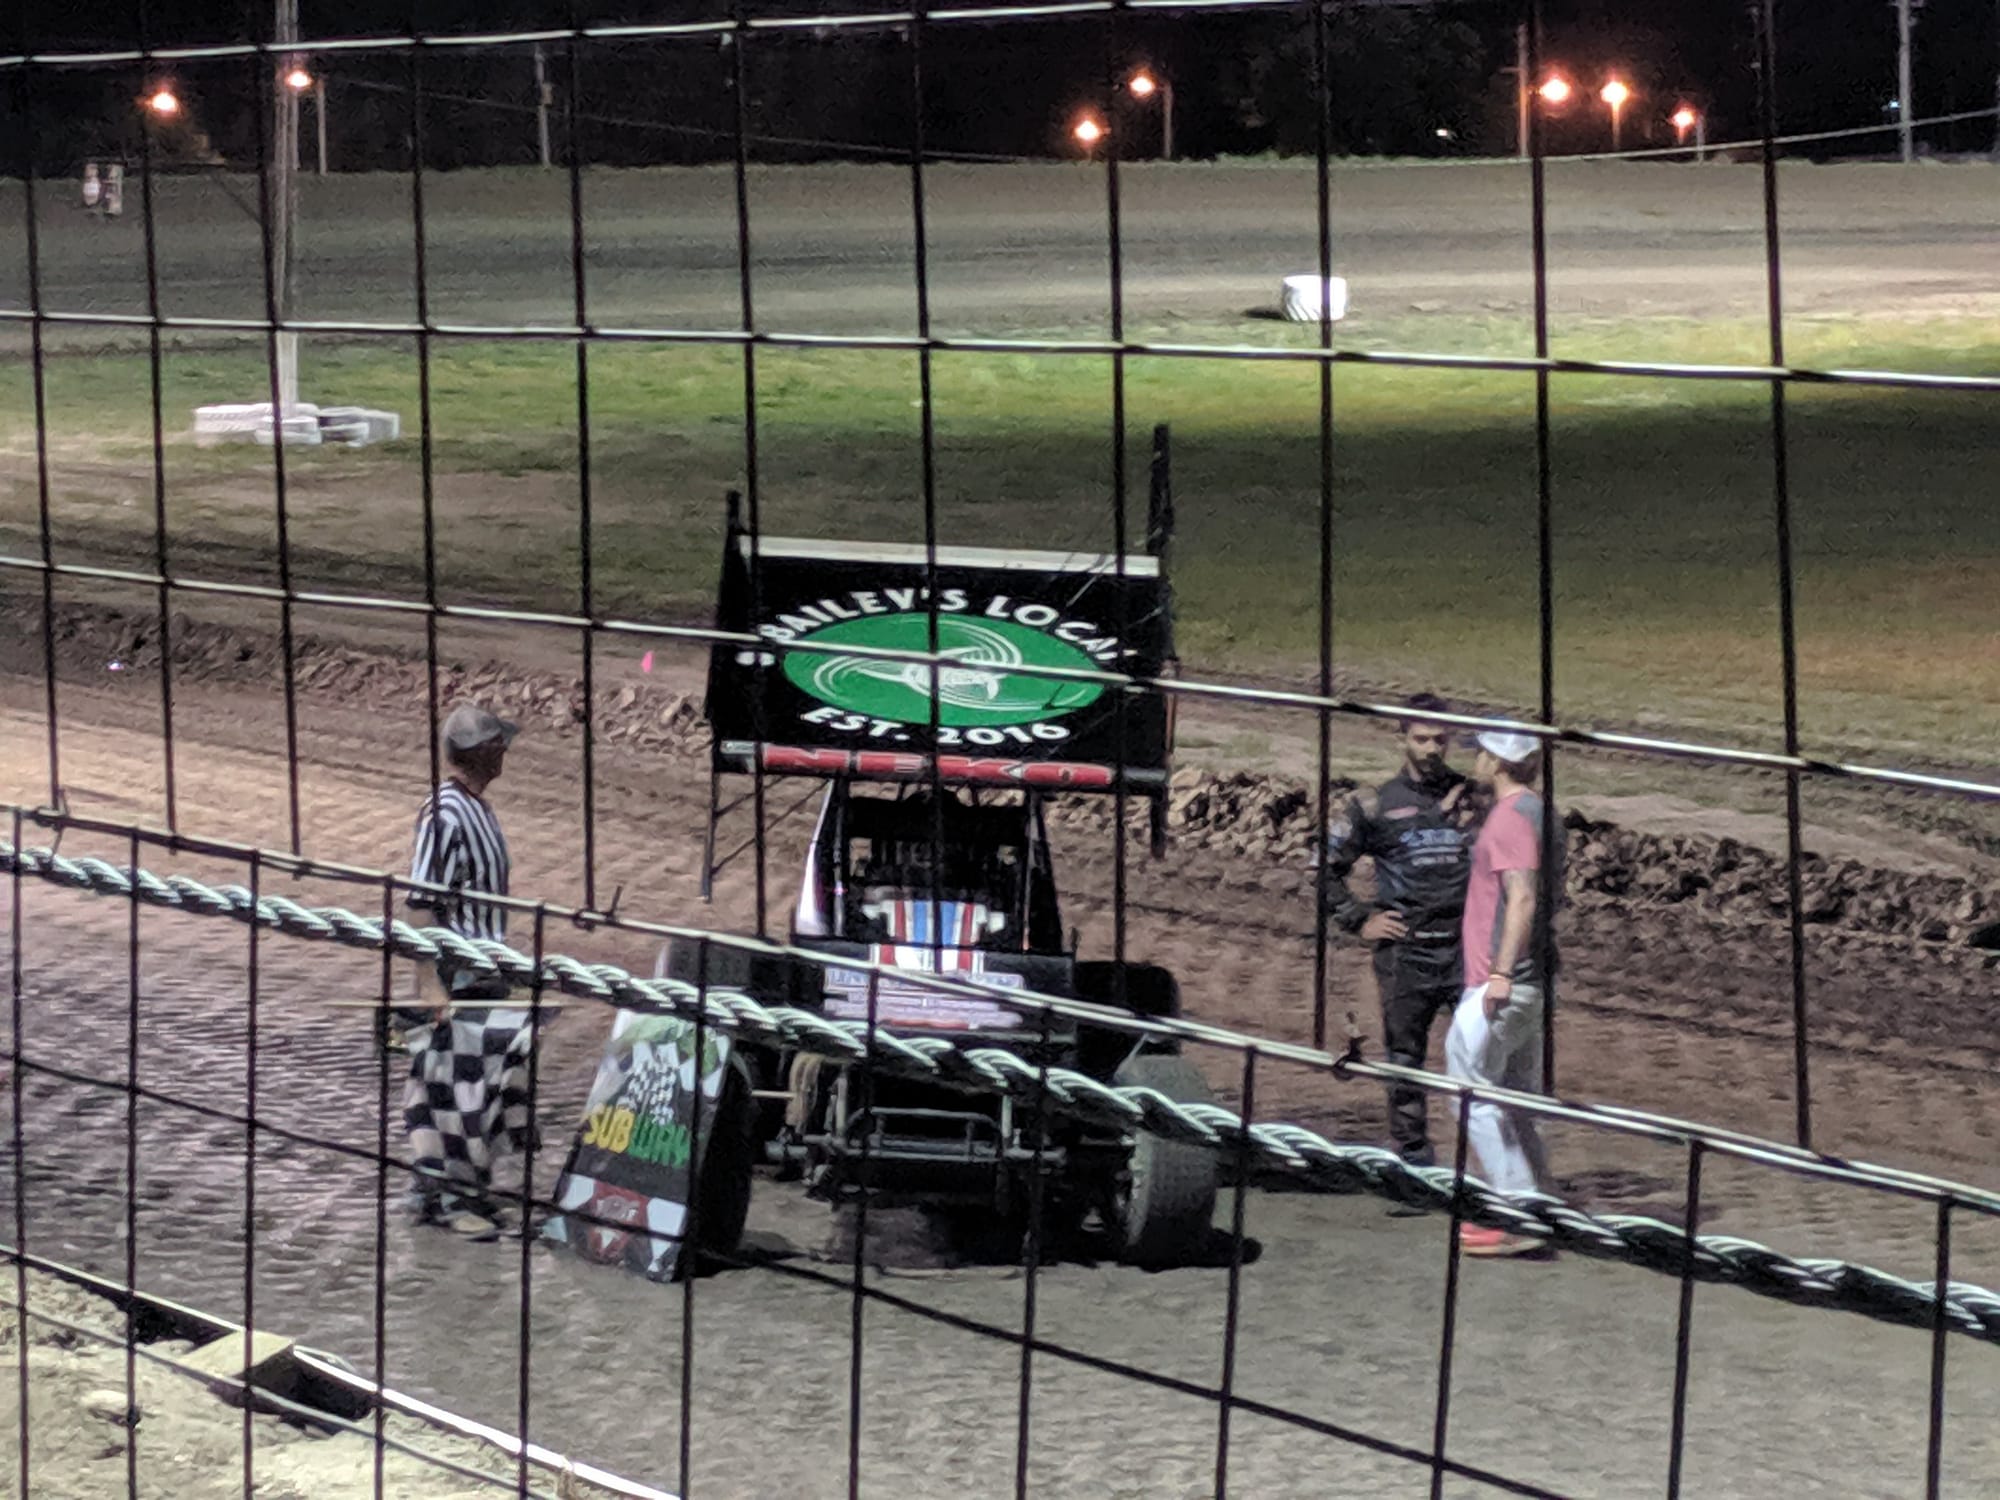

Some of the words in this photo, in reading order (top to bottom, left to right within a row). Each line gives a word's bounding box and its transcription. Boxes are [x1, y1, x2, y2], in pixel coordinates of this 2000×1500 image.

[758, 588, 969, 641] BAILEY'S
[800, 706, 909, 740] EST.
[936, 723, 1070, 745] 2016
